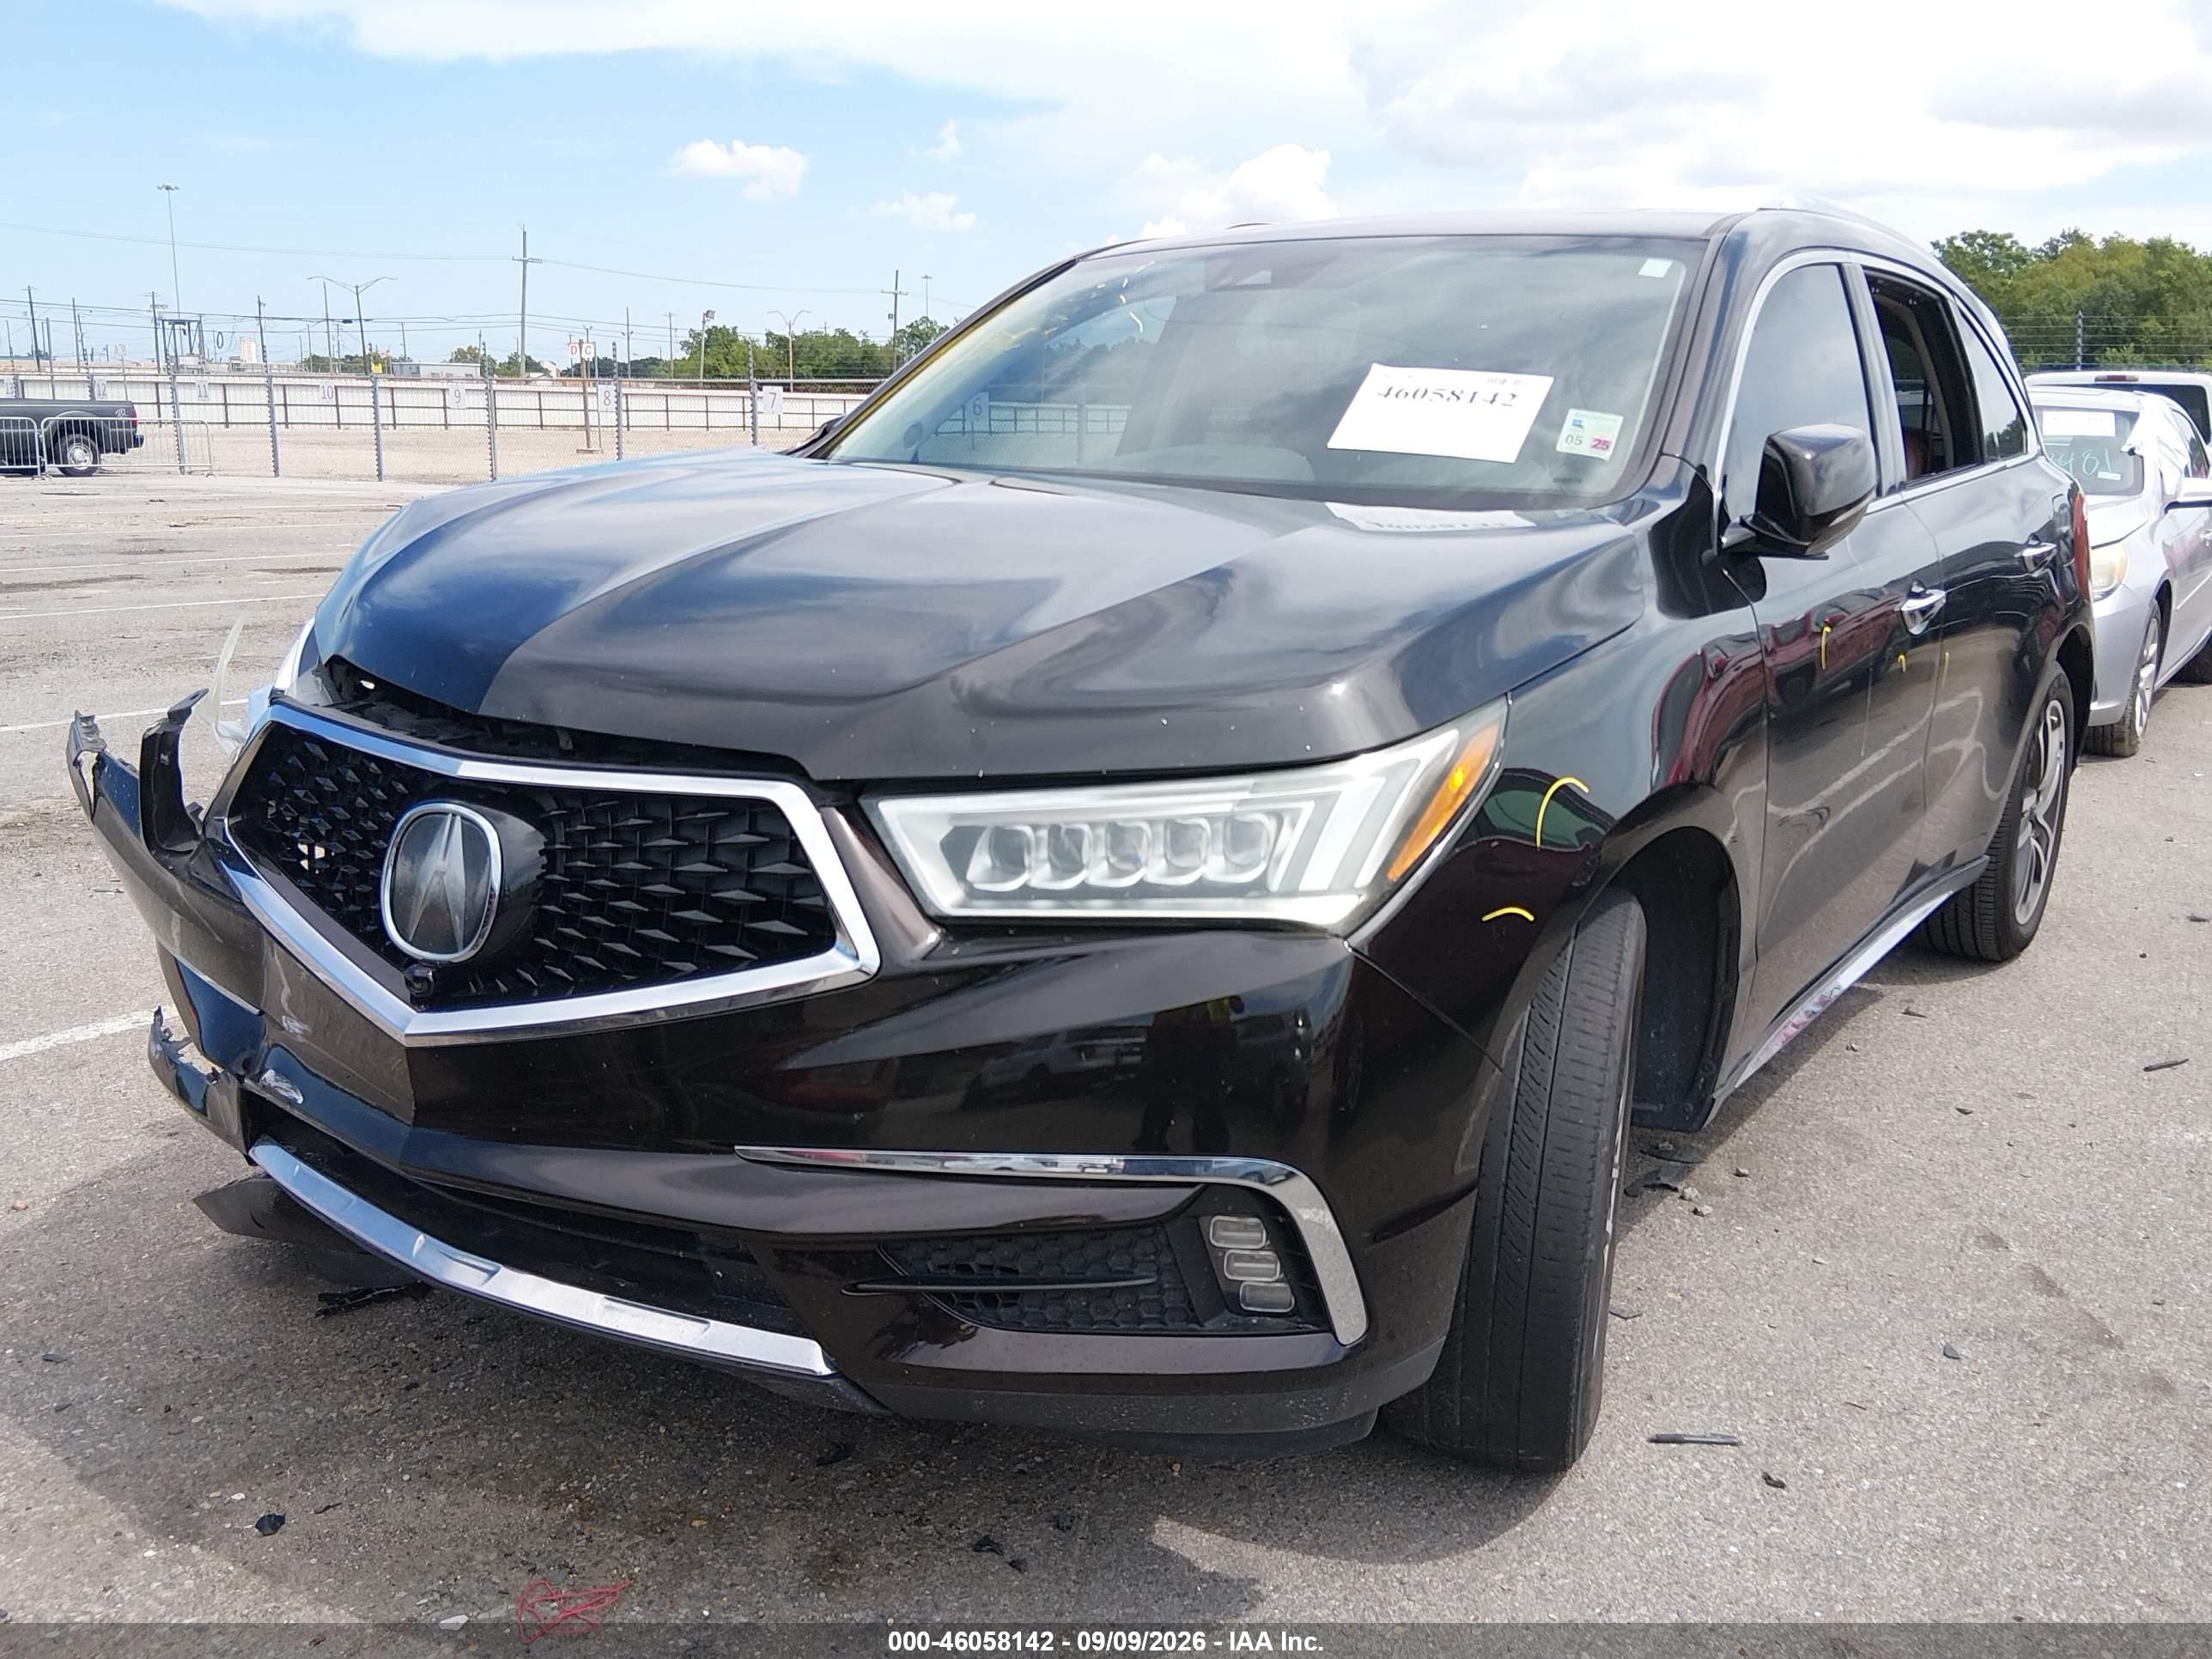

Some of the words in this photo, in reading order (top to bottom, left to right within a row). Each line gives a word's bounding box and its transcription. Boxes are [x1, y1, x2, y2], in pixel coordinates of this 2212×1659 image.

[96, 382, 106, 397] 12
[198, 384, 208, 398] 11
[321, 385, 334, 400] 10
[453, 388, 461, 404] 9
[1377, 386, 1517, 408] 46058142
[603, 390, 611, 406] 8
[769, 392, 777, 410] 7
[972, 398, 982, 416] 6
[1565, 434, 1585, 447] 05
[1590, 438, 1613, 451] 25
